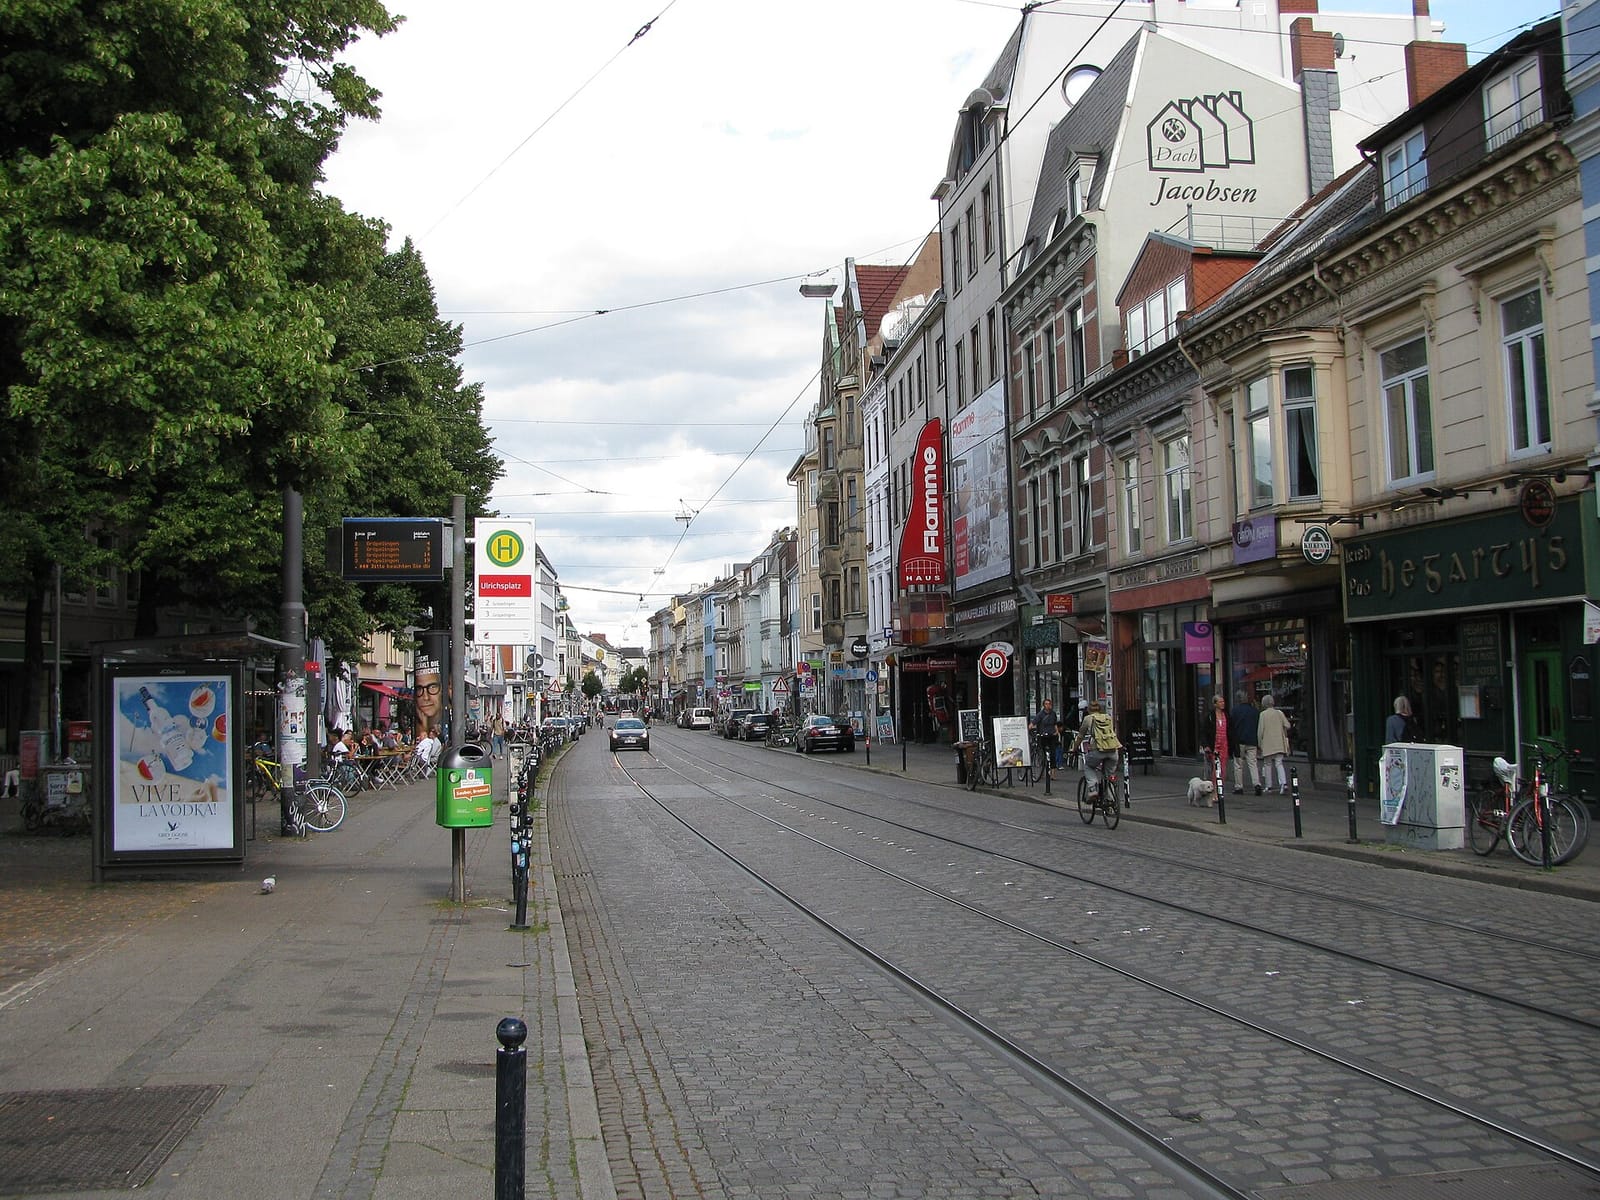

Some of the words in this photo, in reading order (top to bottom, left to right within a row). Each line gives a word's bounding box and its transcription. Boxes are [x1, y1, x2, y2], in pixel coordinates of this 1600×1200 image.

[1156, 146, 1198, 162] Dach
[1150, 176, 1257, 206] Jacobsen
[923, 446, 939, 554] Flamme
[497, 538, 513, 559] H
[480, 582, 522, 591] Ulrichsplatz
[986, 657, 1001, 669] 30
[132, 784, 181, 802] VIVE
[140, 805, 159, 817] LA
[160, 804, 217, 817] VODKA!
